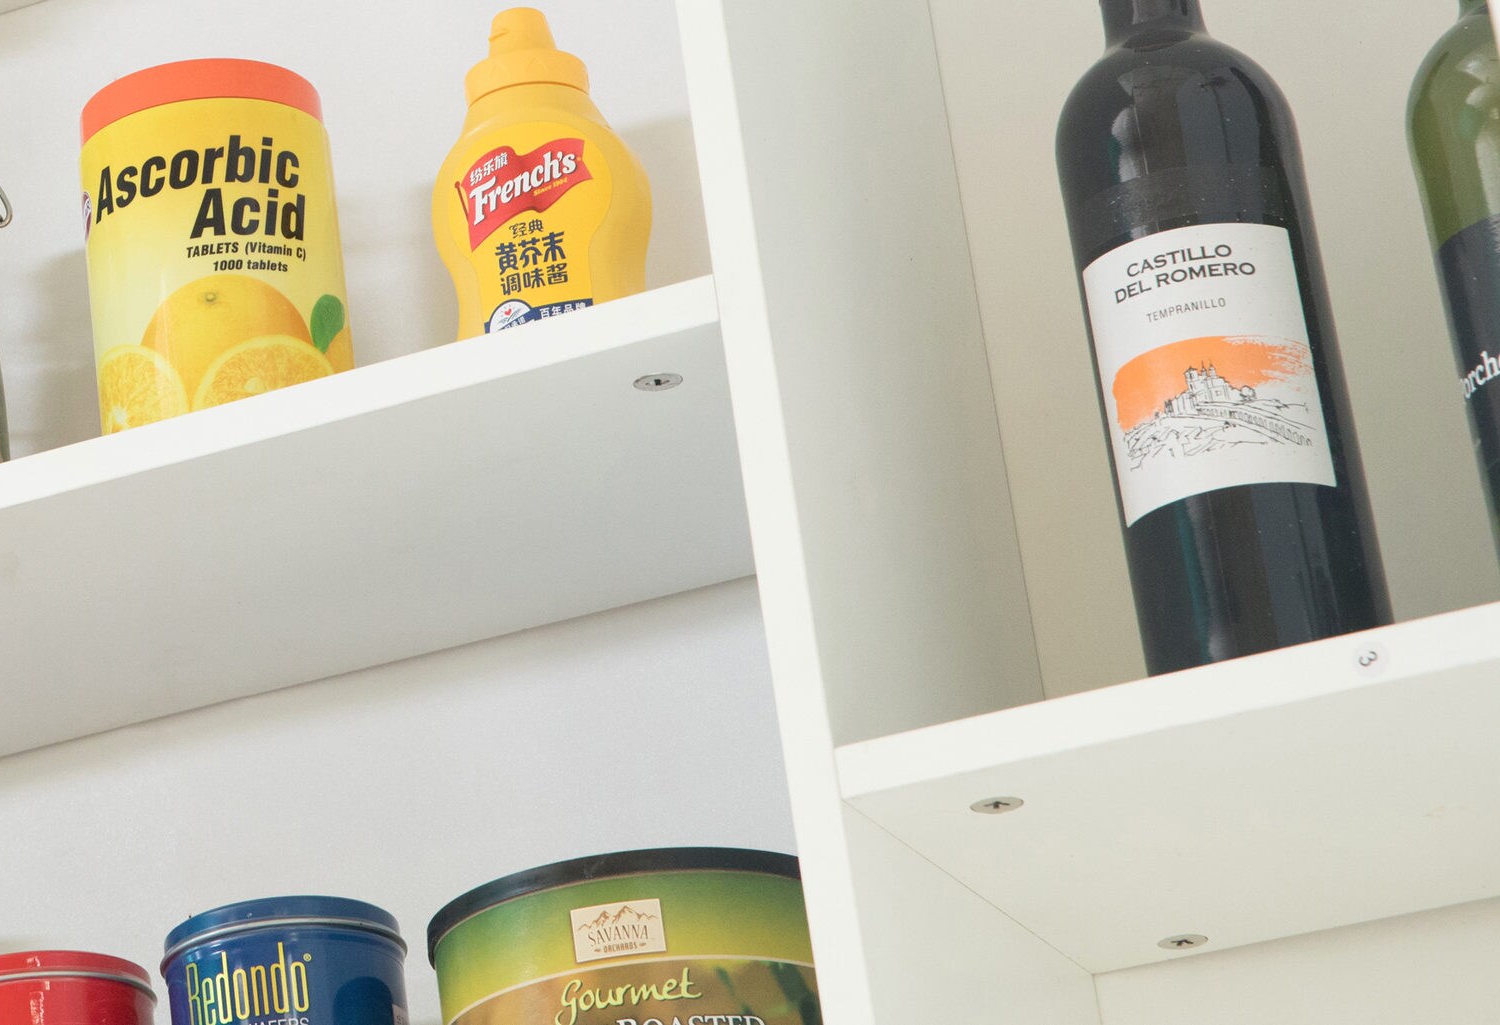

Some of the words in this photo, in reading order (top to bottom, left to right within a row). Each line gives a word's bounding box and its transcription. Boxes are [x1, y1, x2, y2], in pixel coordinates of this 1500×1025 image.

[96, 135, 300, 224] Ascorbic
[469, 151, 577, 226] French's
[190, 188, 306, 241] Acid
[509, 219, 544, 239] 经典
[187, 242, 239, 258] TABLETS
[245, 242, 293, 257] (Vitamin
[296, 247, 306, 261] C)
[213, 259, 243, 272] 1000
[247, 260, 288, 272] tablets
[495, 231, 566, 275] 黄芥末
[1126, 244, 1232, 278] CASTILLO
[500, 262, 568, 296] 调味酱
[1114, 280, 1152, 304] DEL
[1156, 262, 1256, 288] ROMERO
[1146, 297, 1226, 323] TEMPRANILLO
[588, 924, 649, 947] SAVANNA
[603, 941, 638, 954] ORCHARDS
[555, 967, 702, 1025] Gourmet
